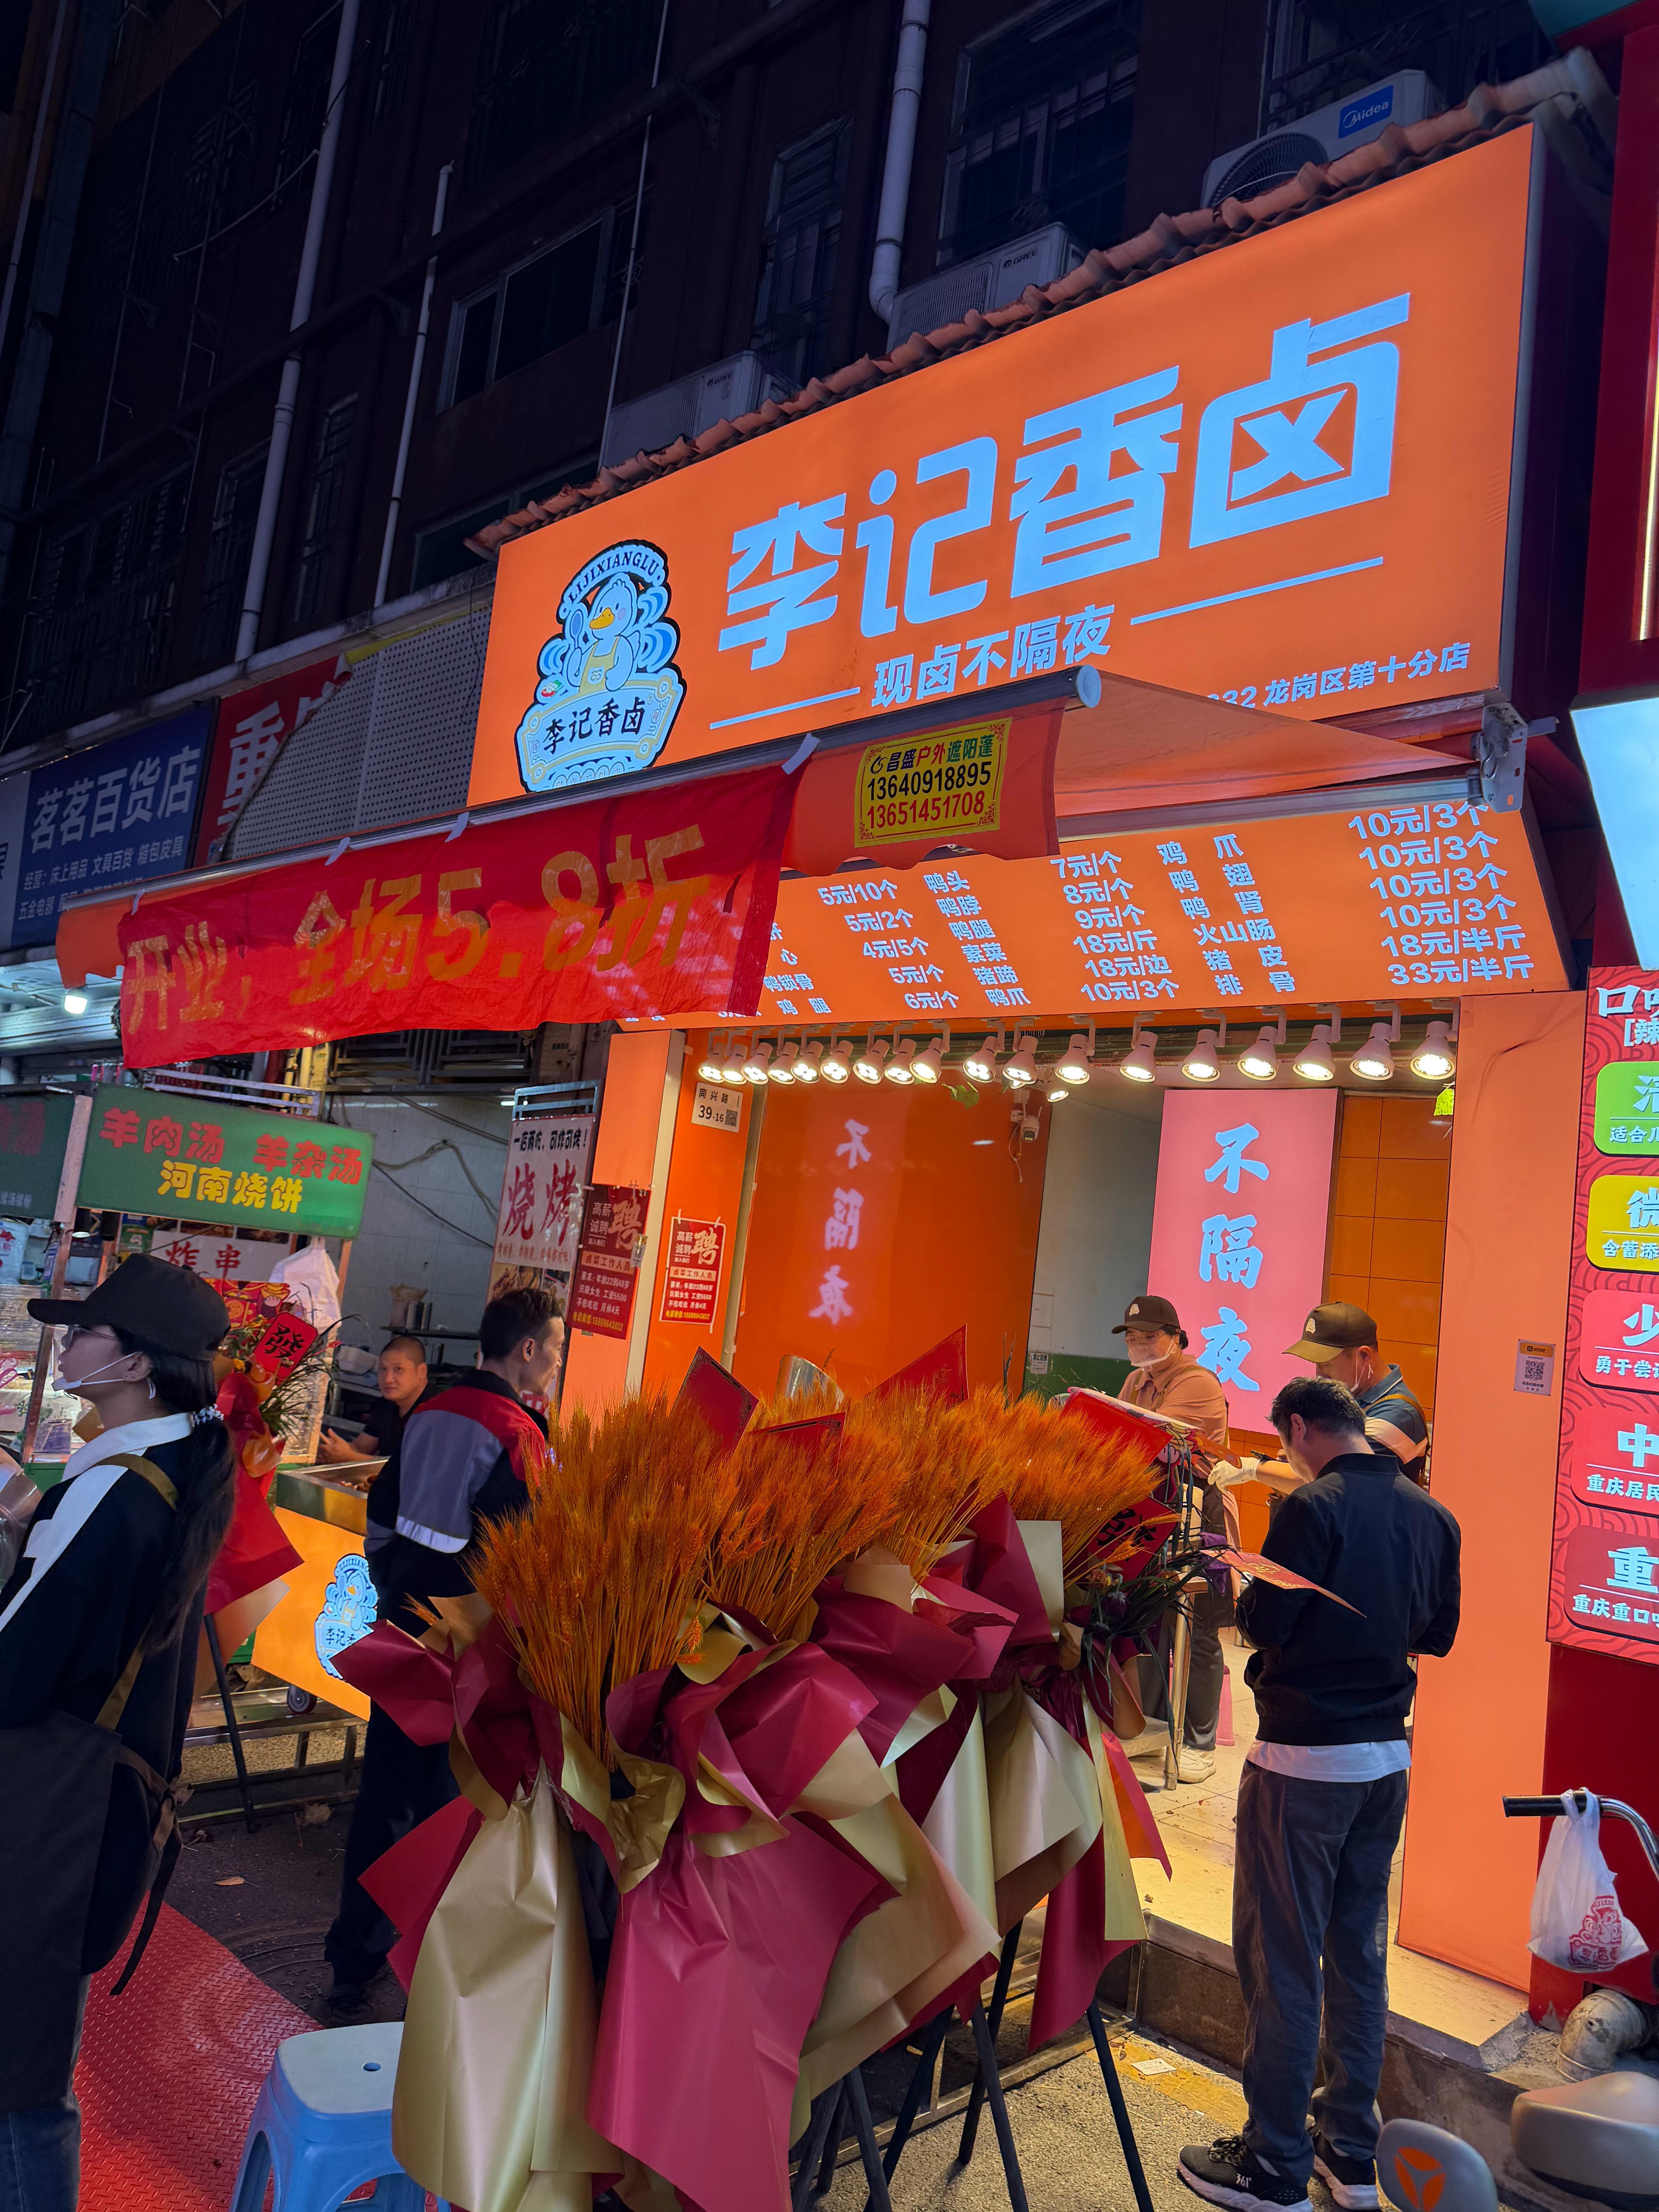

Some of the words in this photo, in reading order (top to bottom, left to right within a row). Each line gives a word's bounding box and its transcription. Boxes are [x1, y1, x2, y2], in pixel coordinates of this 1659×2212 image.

[1343, 101, 1389, 128] Midea
[1013, 248, 1038, 265] GREE
[718, 291, 1412, 670] 李记香卤
[568, 550, 659, 603] LIJIXIANGLU
[871, 603, 1112, 712] 现卤不隔夜
[1207, 686, 1257, 709] 32
[1262, 641, 1471, 707] 龙岗区第十分店
[543, 696, 645, 755] 李记香卤
[31, 744, 201, 854] 茗茗百货店
[867, 761, 992, 801] 13640918895
[867, 790, 985, 829] 13651451708
[91, 847, 134, 876] 文具百货
[923, 871, 969, 893] 鸭头
[1050, 850, 1122, 879] 7元/个
[1348, 801, 1489, 839] 10元/3个
[818, 879, 896, 905] 5元/10个
[936, 895, 981, 917] 鸭脖
[1062, 877, 1134, 905] 8元/个
[1359, 831, 1498, 869] 10元/3个
[18, 895, 55, 921] 五金电器
[845, 909, 912, 932] 5元/2个
[949, 920, 995, 941] 鸭腿
[1075, 903, 1145, 929] 9元/个
[1370, 863, 1508, 899] 10元/3个
[863, 937, 928, 958] 4元/5个
[961, 943, 1006, 963] 素菜
[1073, 929, 1158, 955] 18元/斤
[1192, 918, 1277, 946] 火山肠
[1380, 894, 1516, 928] 10元/3个
[763, 974, 813, 992] 鸭锁骨
[888, 965, 943, 984] 5元/个
[973, 965, 1018, 985] 猪蹄
[1084, 954, 1172, 978] 18元/边
[1381, 924, 1525, 957] 18元/半斤
[904, 991, 958, 1009] 6元/个
[985, 988, 1030, 1006] 鸭爪
[1080, 978, 1180, 1001] 10元/3个
[1388, 954, 1534, 985] 33元/半斤
[698, 1105, 724, 1123] 39-16
[699, 1088, 728, 1104] 同兴路
[100, 1107, 225, 1163] 羊肉汤
[253, 1133, 363, 1185] 羊杂汤
[158, 1159, 303, 1213] 河南烧饼
[502, 1159, 579, 1247] 烧烤
[592, 1202, 612, 1217] 高薪
[590, 1219, 609, 1235] 诚聘
[607, 1197, 642, 1250] 聘
[677, 1231, 694, 1243] 高薪
[691, 1227, 719, 1265] 聘
[165, 1241, 241, 1280] 炸串
[675, 1243, 692, 1255] 诚聘
[1197, 1122, 1269, 1393] 不隔夜
[264, 1323, 304, 1359] 發
[1618, 1423, 1659, 1468] 中
[1606, 1547, 1659, 1594] 重
